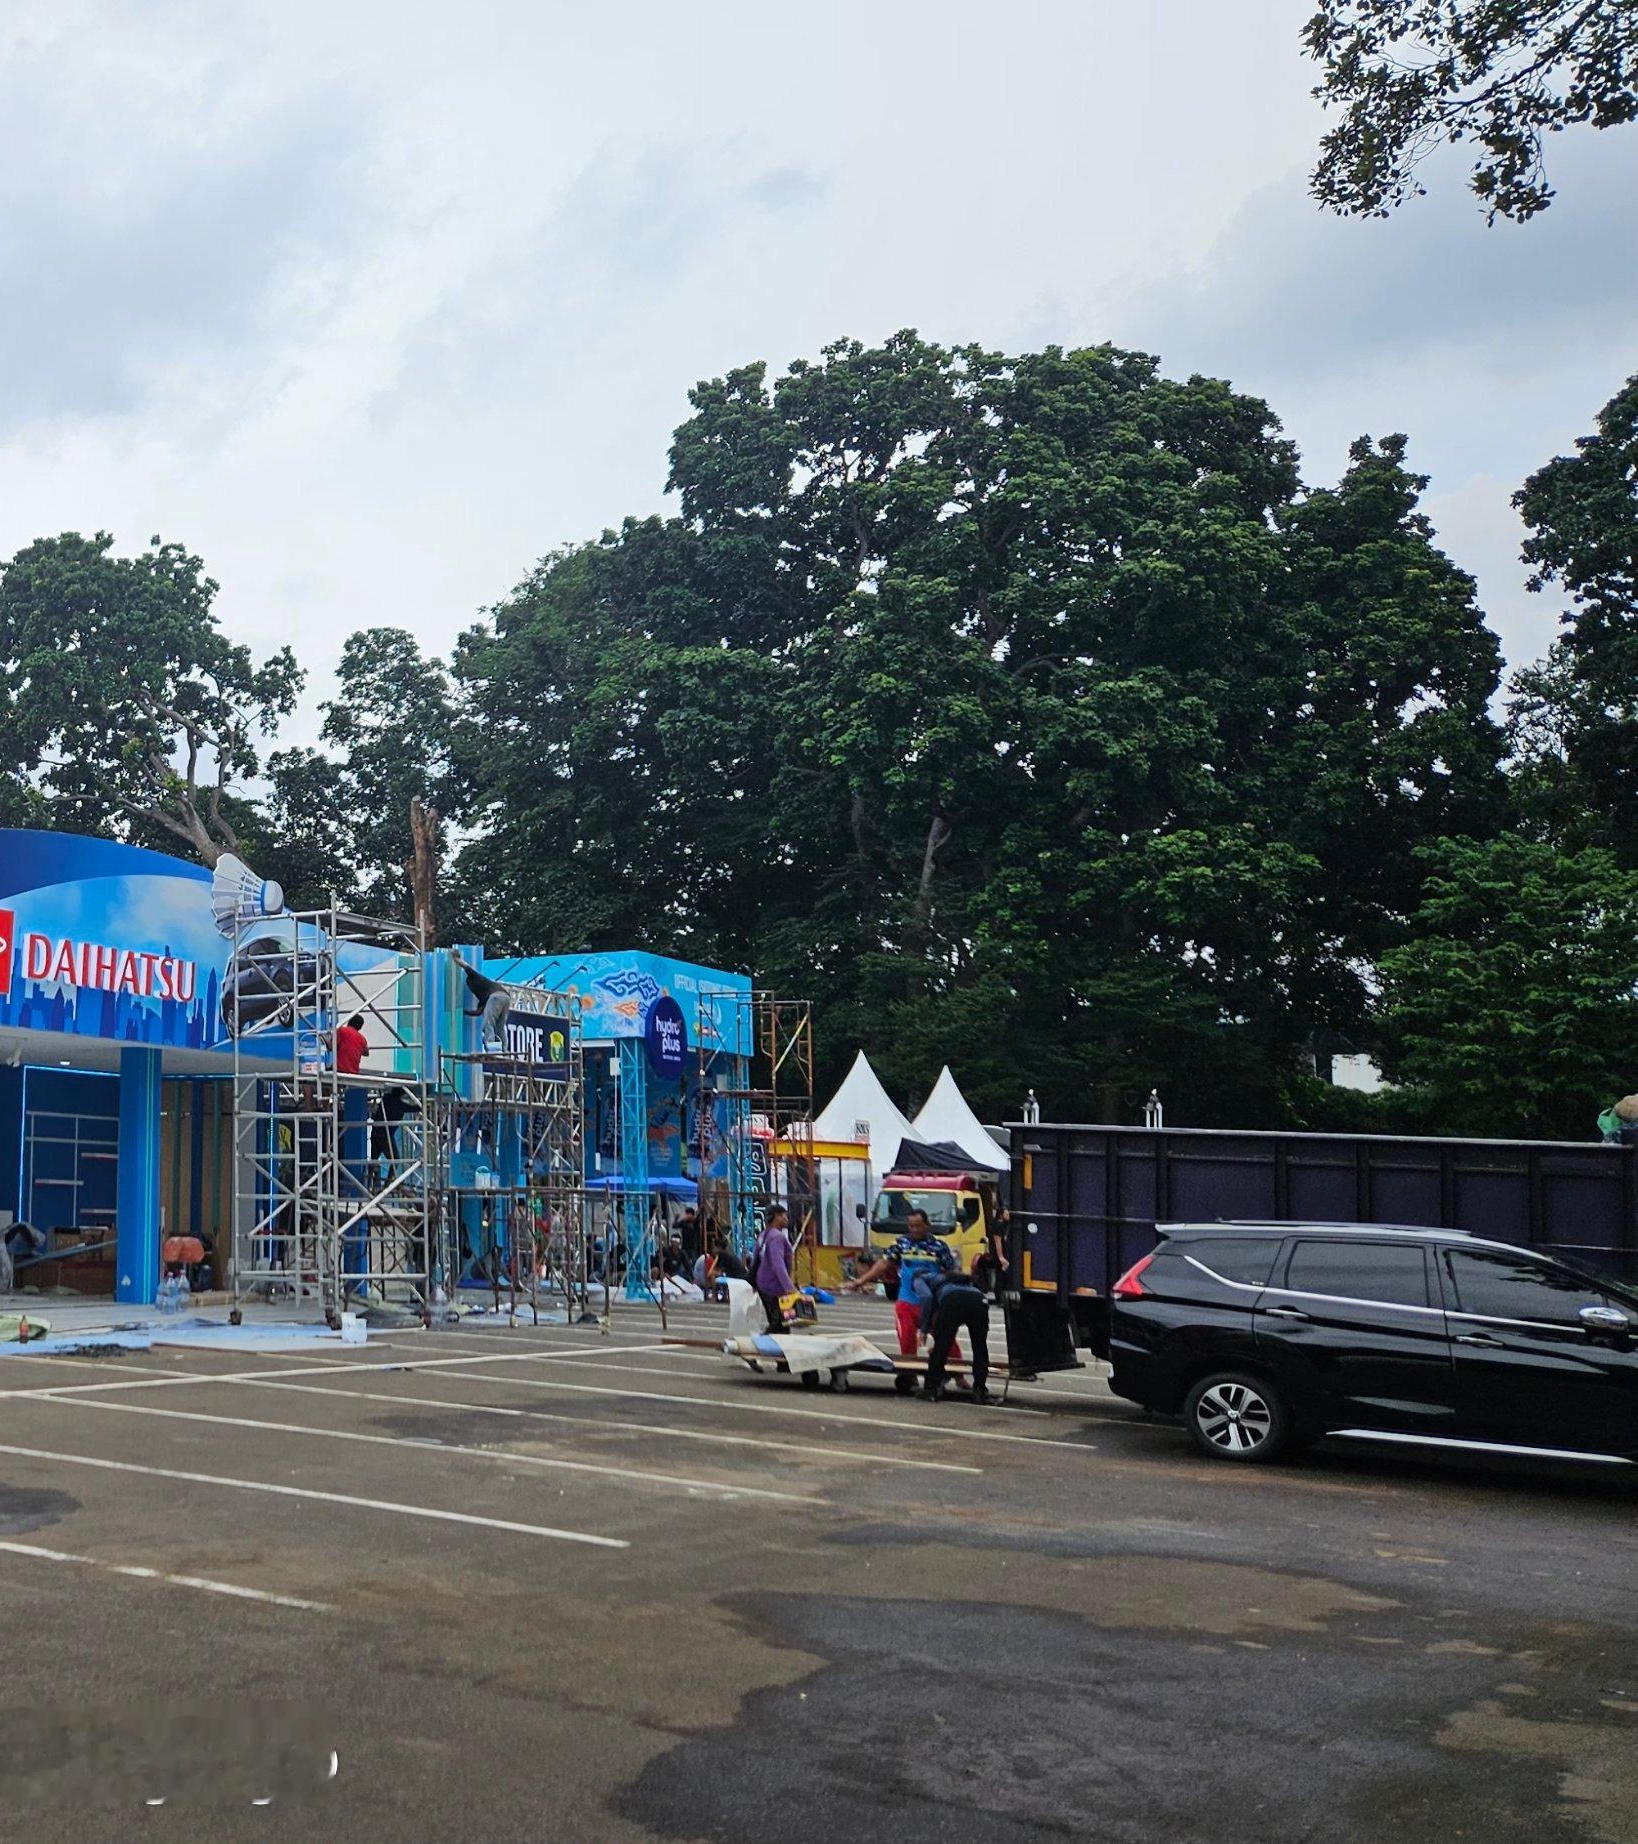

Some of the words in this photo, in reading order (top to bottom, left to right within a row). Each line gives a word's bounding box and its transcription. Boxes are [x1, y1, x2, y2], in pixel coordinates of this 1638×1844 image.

[22, 933, 196, 1002] DAIHATSU
[504, 1024, 544, 1064] TORE
[662, 1035, 681, 1053] plus
